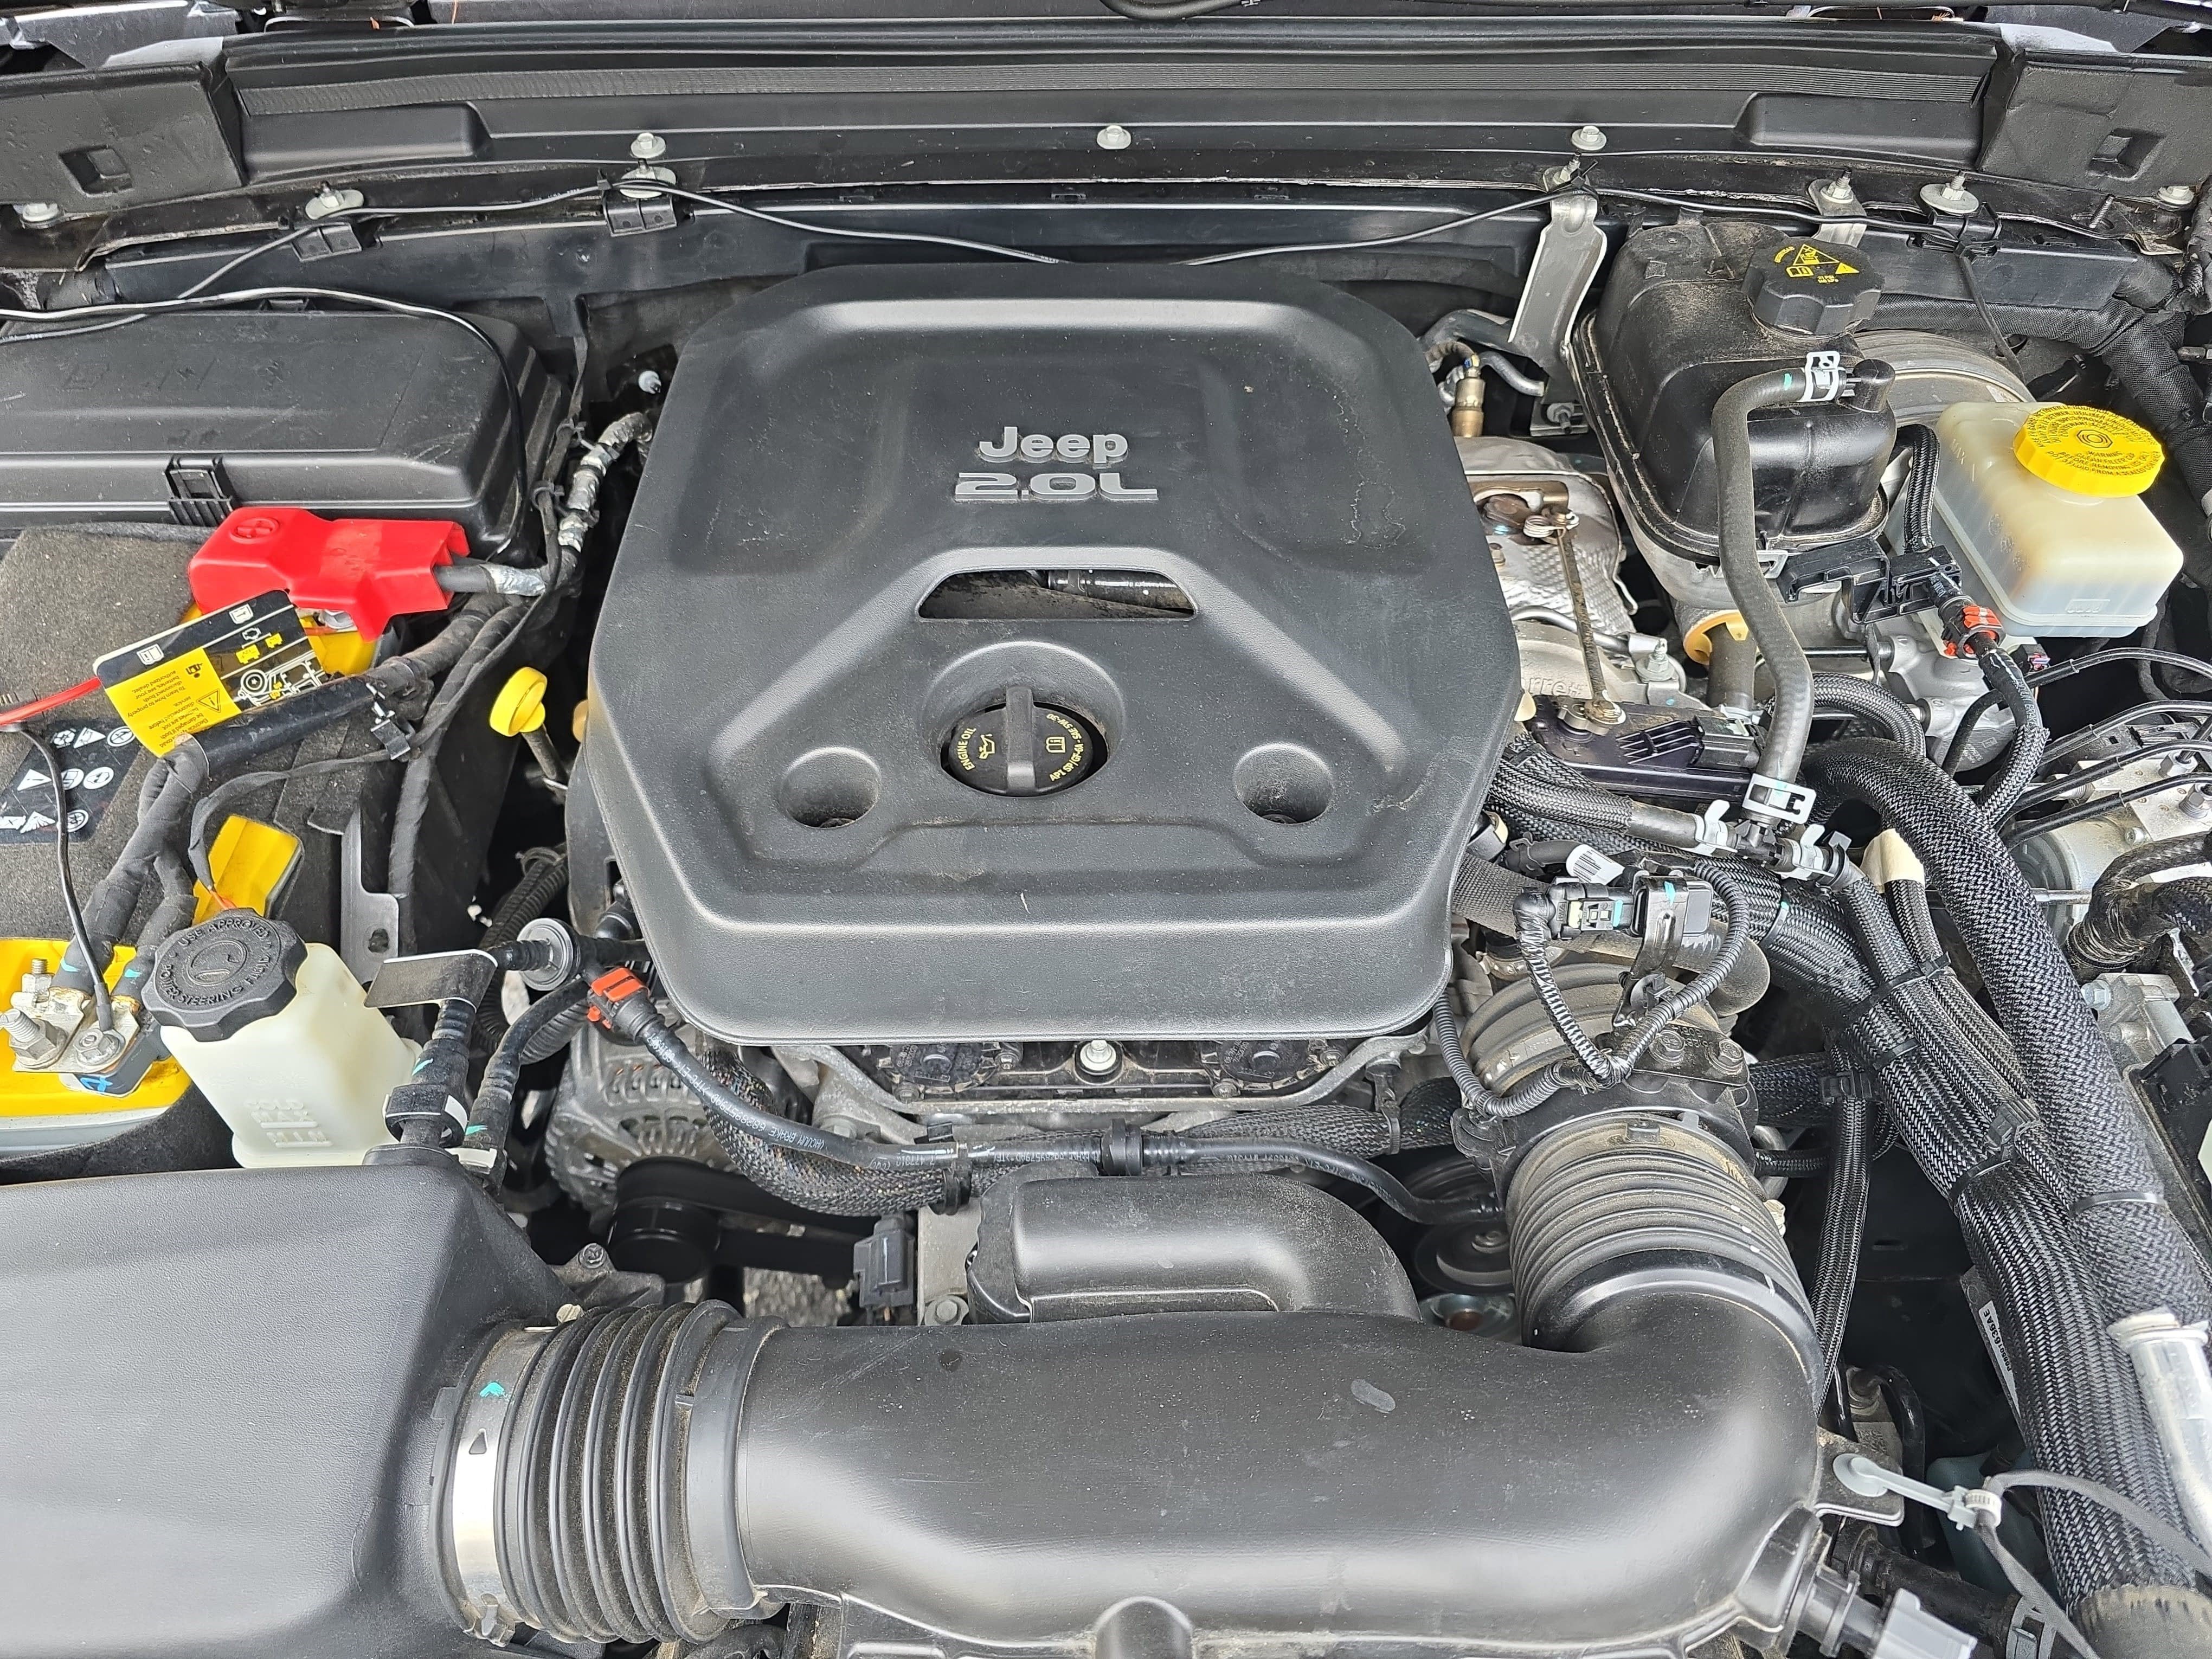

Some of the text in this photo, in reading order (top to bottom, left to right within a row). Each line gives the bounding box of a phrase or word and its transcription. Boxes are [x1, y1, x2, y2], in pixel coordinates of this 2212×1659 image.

[979, 426, 1128, 468] Jeep
[954, 472, 1158, 501] 2.0L
[1046, 713, 1073, 730] 5W-30
[1068, 727, 1082, 740] SAE
[956, 728, 976, 771] ENGINE OIL
[1049, 770, 1066, 781] API
[178, 919, 271, 947] USE APPROVED
[178, 986, 244, 1006] STEERING
[768, 1126, 798, 1143] BRAKE
[798, 1134, 826, 1150] VACUUM
